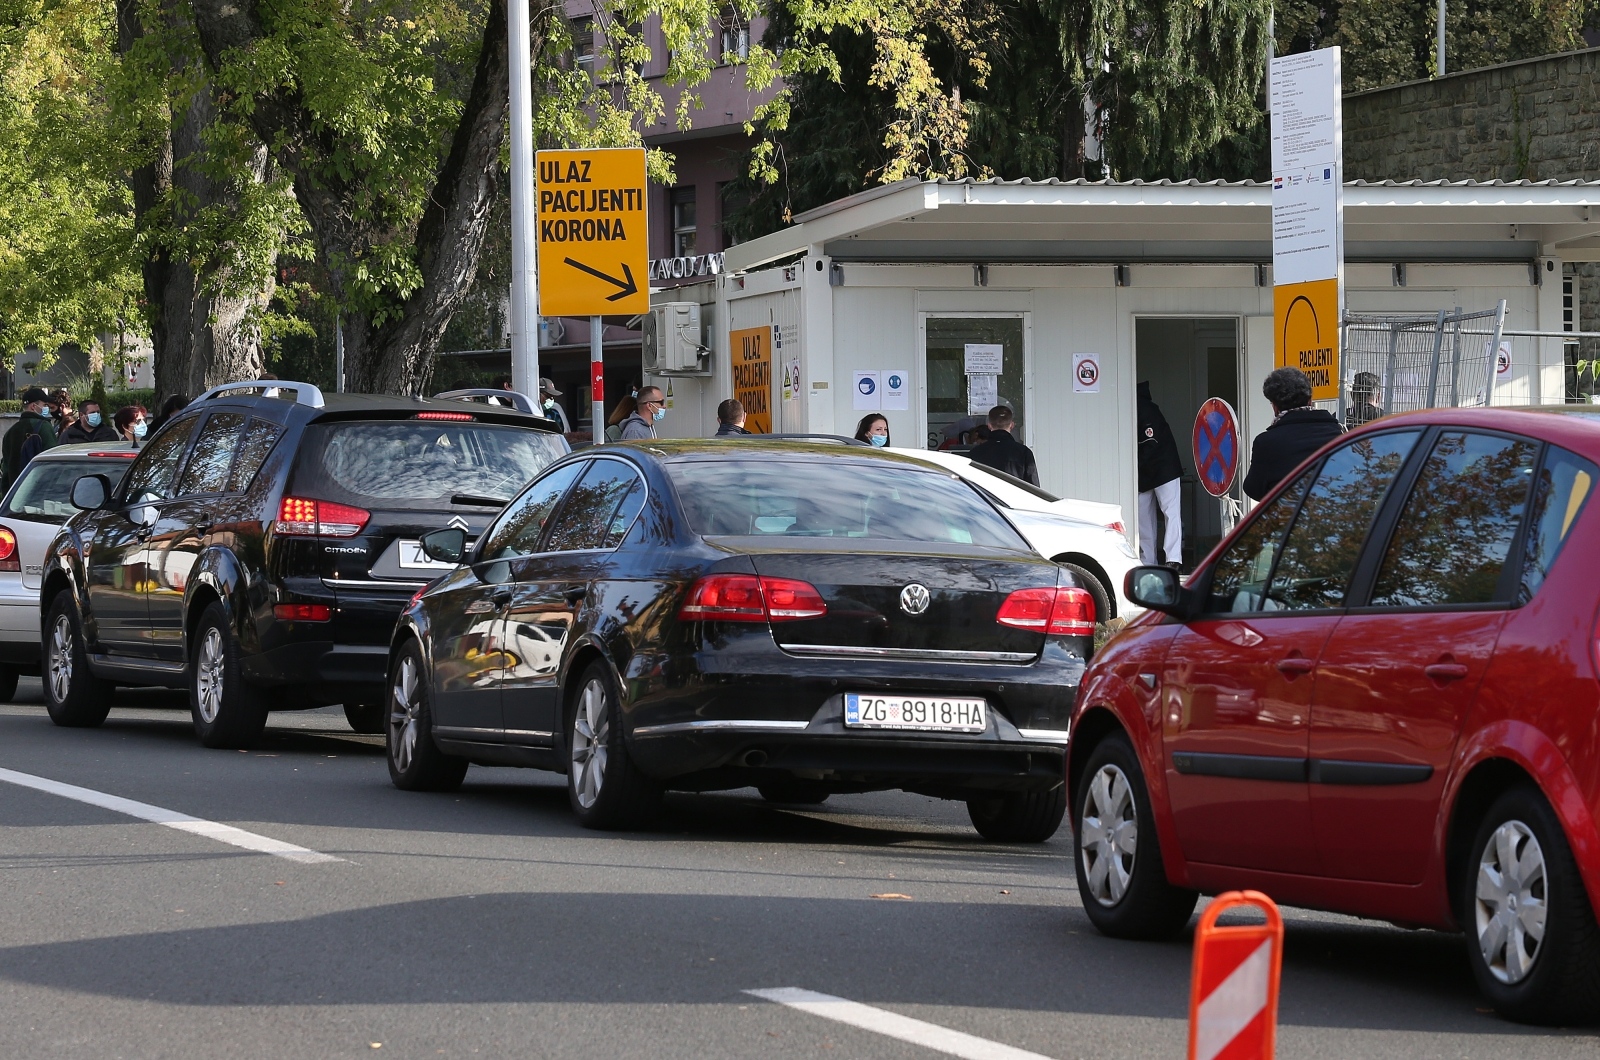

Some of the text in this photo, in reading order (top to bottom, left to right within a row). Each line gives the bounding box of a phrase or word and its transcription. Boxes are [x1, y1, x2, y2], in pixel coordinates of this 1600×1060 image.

[540, 160, 592, 184] ULAZ
[541, 188, 643, 213] PACIJENTI
[541, 218, 626, 242] KORONA
[649, 256, 694, 280] ZAVOD
[742, 334, 761, 361] ULAZ
[1299, 348, 1333, 368] PACIJENTI
[733, 360, 769, 390] PACIJENTI
[324, 546, 367, 554] CITROËN
[900, 583, 931, 615] VW
[847, 712, 859, 720] HR
[861, 699, 887, 721] ZG
